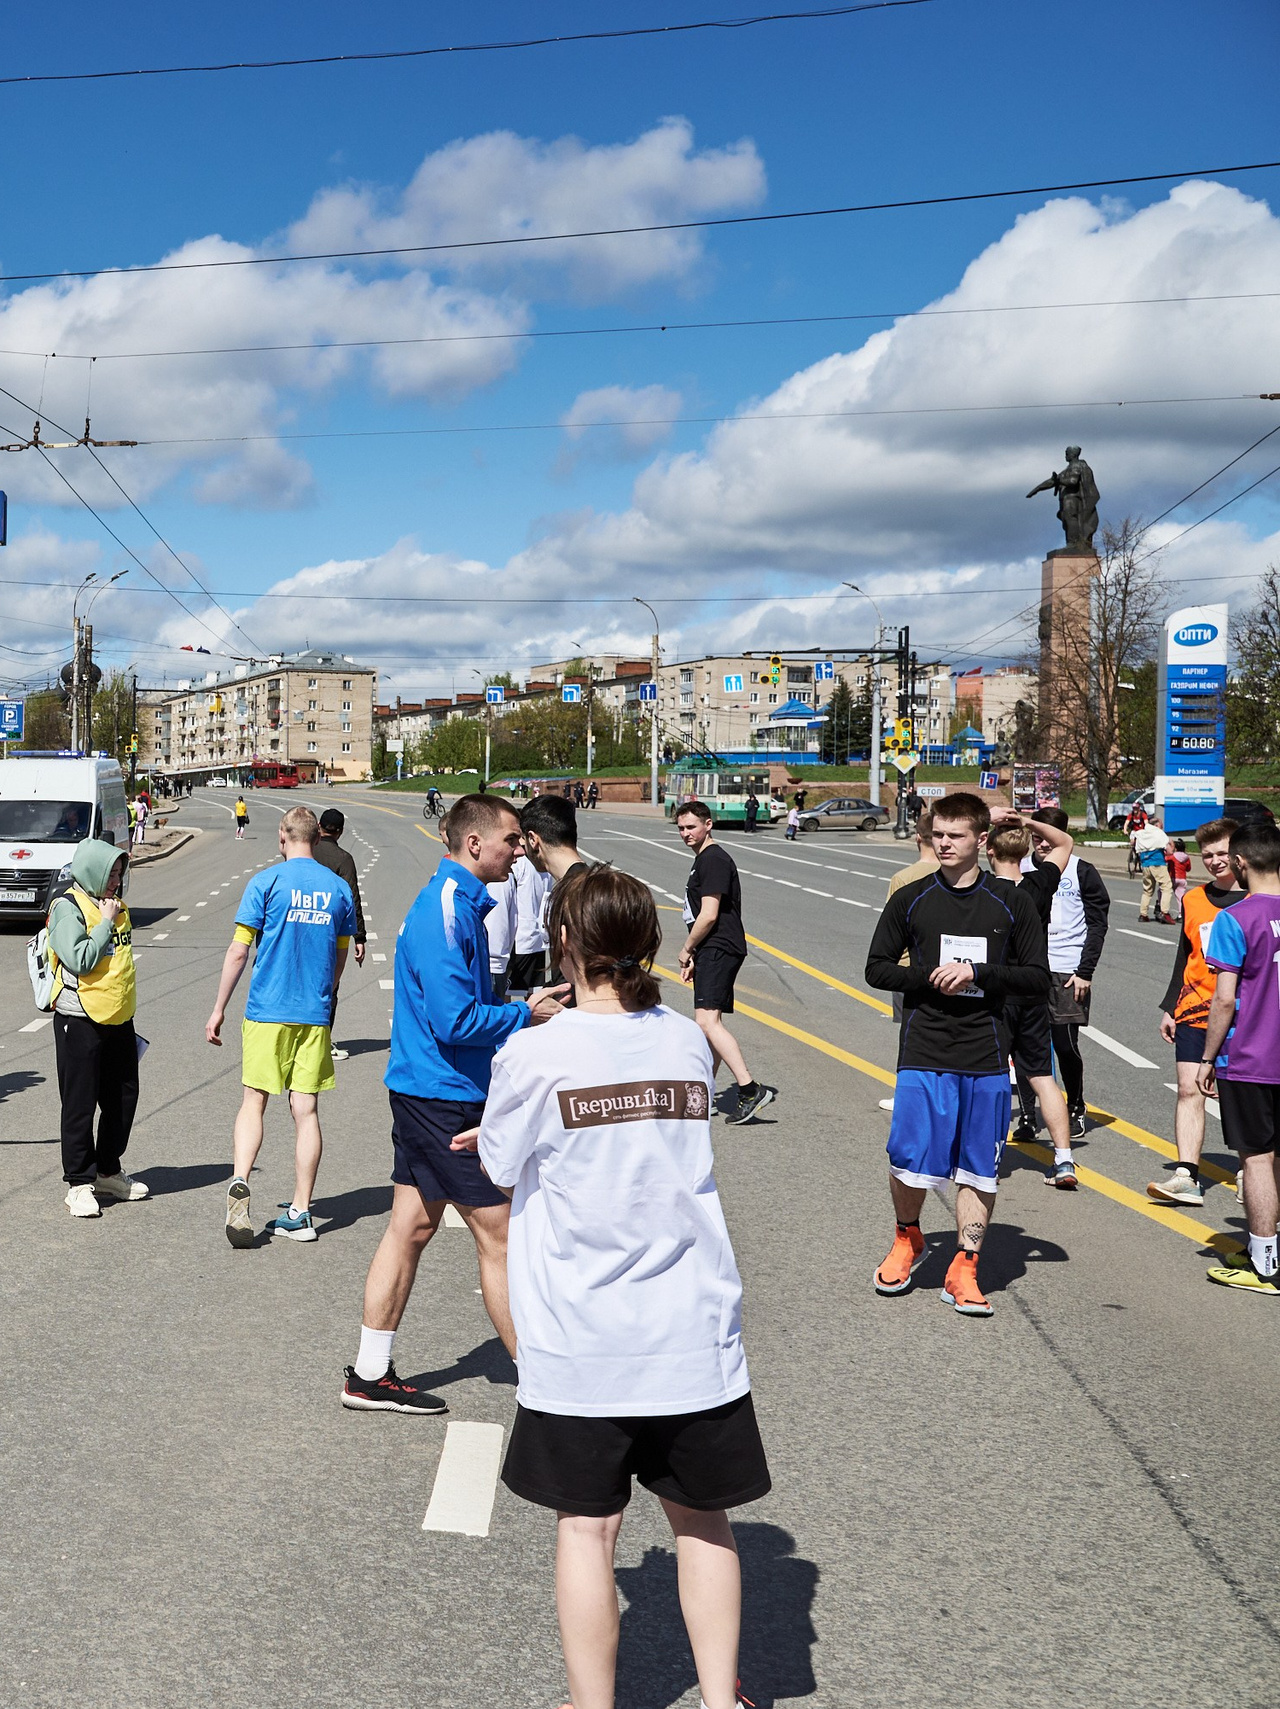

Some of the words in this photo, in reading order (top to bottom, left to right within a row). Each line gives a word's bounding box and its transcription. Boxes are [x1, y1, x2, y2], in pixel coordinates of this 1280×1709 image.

[1179, 629, 1212, 641] ОПТИ
[1182, 737, 1215, 749] 60.80
[1178, 767, 1209, 775] Магазин
[921, 788, 942, 796] СТОП
[291, 889, 332, 910] ИвГУ
[287, 910, 332, 926] UNILIGA
